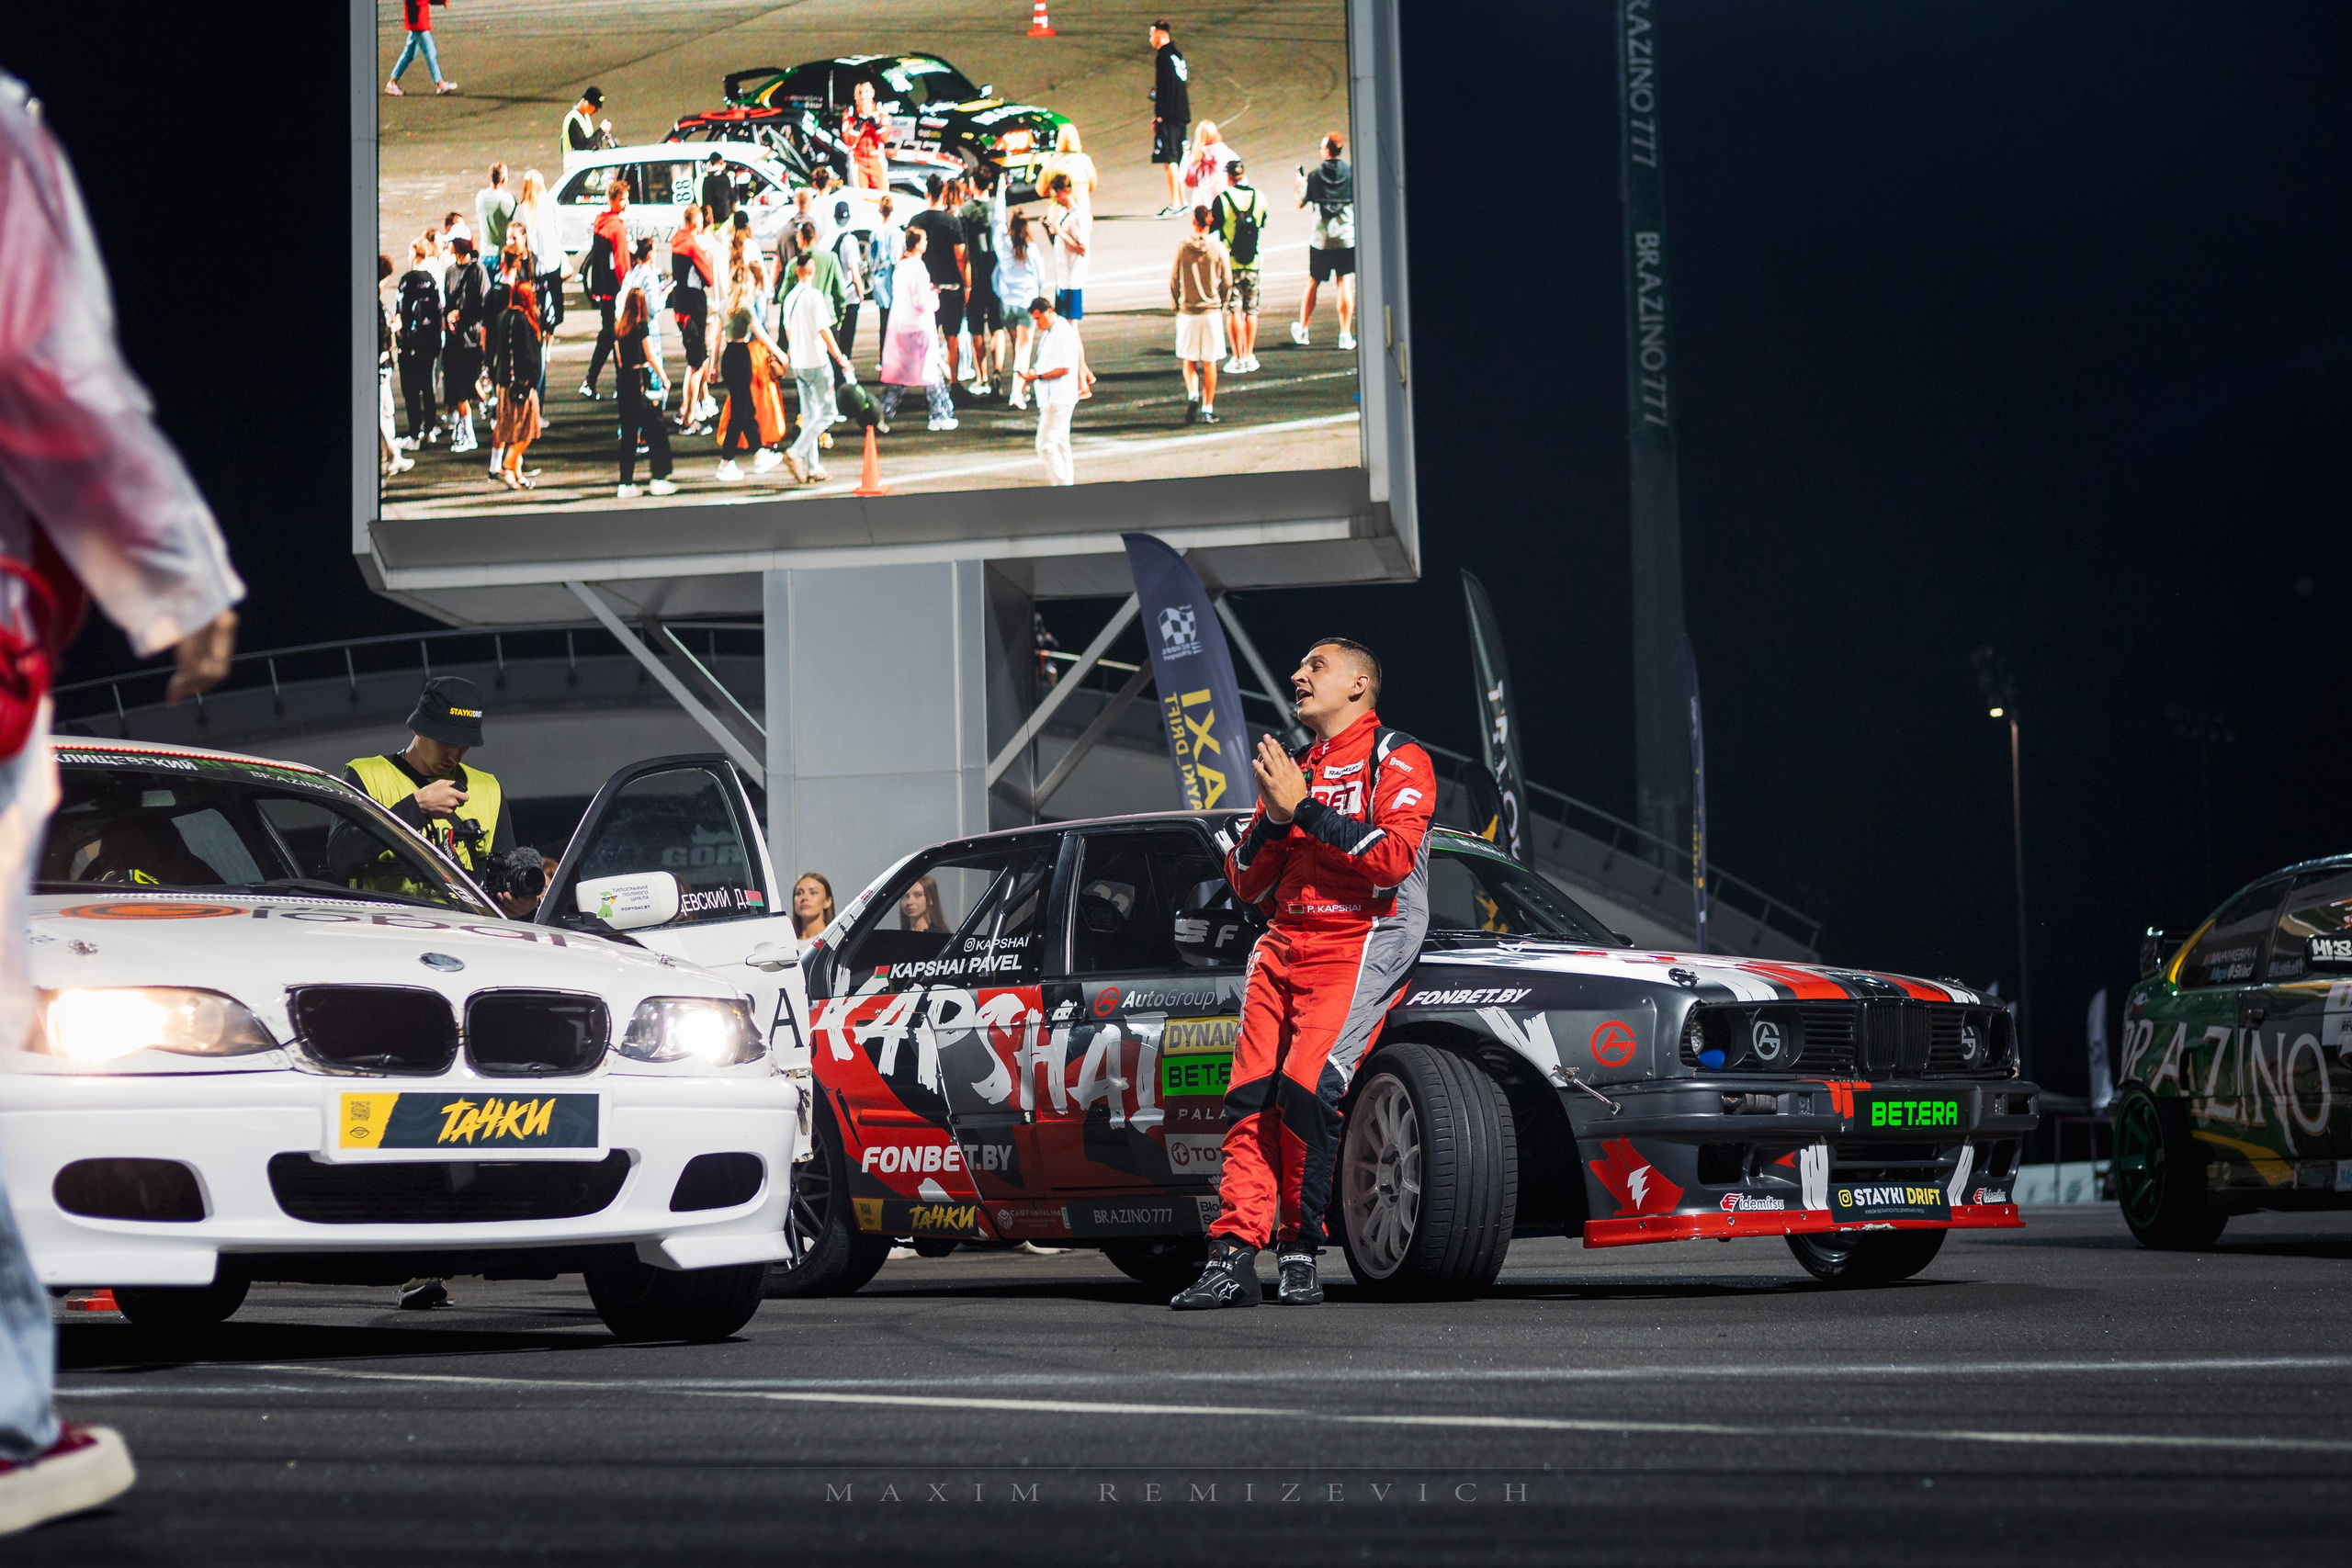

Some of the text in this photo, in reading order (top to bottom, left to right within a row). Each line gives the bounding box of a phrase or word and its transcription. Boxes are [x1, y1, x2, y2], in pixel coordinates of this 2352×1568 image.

[1317, 905, 1361, 913] KAPSHAI
[889, 953, 1023, 979] KAPSHAI PAVEL
[1122, 988, 1216, 1010] AutoGroup
[1407, 988, 1532, 1006] FONBET.BY
[862, 1145, 1012, 1174] FONBET.BY
[1855, 1187, 1941, 1206] STAYKI DRIFT
[1093, 1208, 1172, 1224] BRAZINO777
